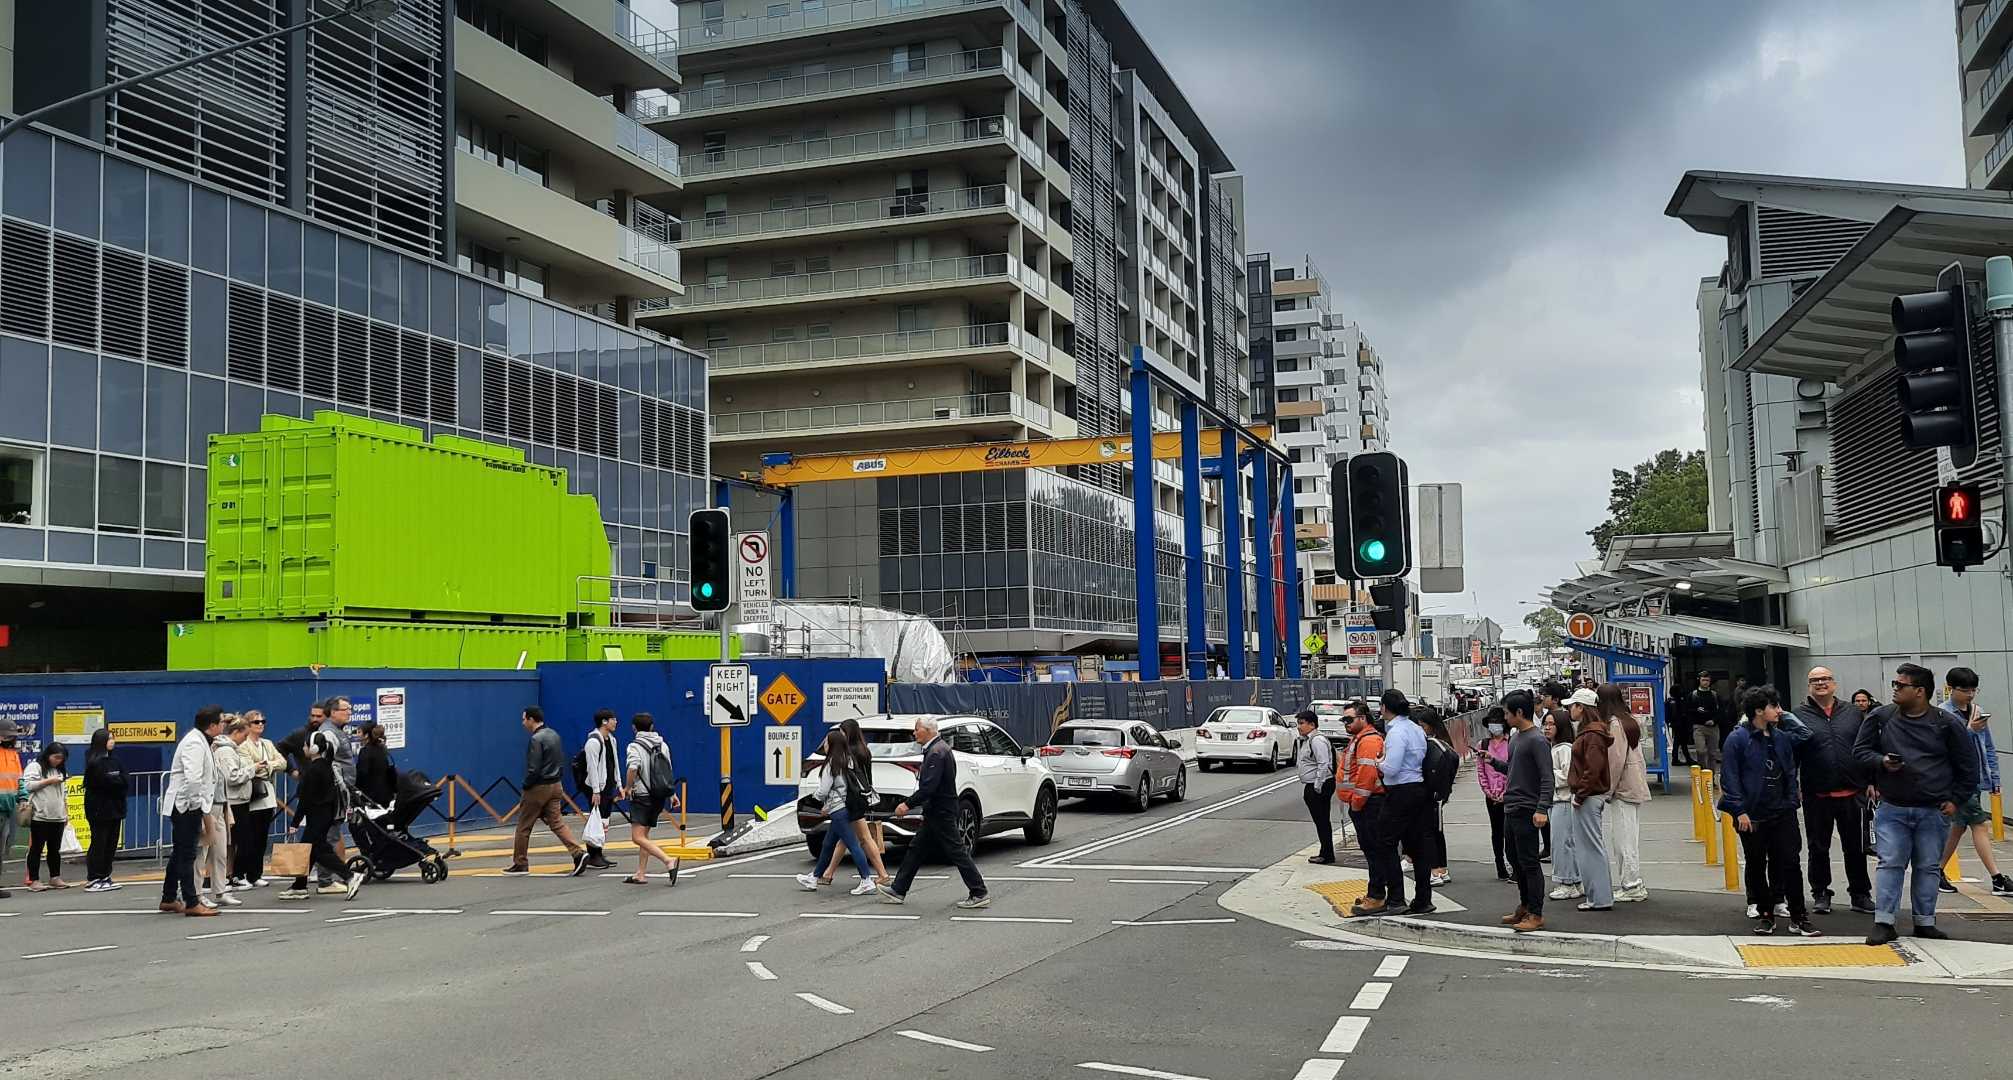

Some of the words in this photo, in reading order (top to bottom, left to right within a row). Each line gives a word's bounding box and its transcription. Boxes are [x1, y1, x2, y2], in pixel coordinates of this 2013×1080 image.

[985, 446, 1030, 460] Eilbeck
[857, 460, 884, 470] ABUS
[746, 567, 763, 577] NO
[744, 579, 765, 587] LEFT
[744, 589, 767, 597] TURN
[1575, 619, 1587, 635] T
[717, 669, 742, 679] KEEP
[716, 682, 744, 692] RIGHT
[767, 693, 798, 705] GATE
[19, 703, 39, 711] open
[353, 703, 371, 712] open
[6, 712, 40, 720] business
[351, 713, 372, 721] siness
[111, 727, 158, 737] PEDESTRIANS
[768, 731, 790, 740] BOURKE
[791, 731, 799, 740] ST
